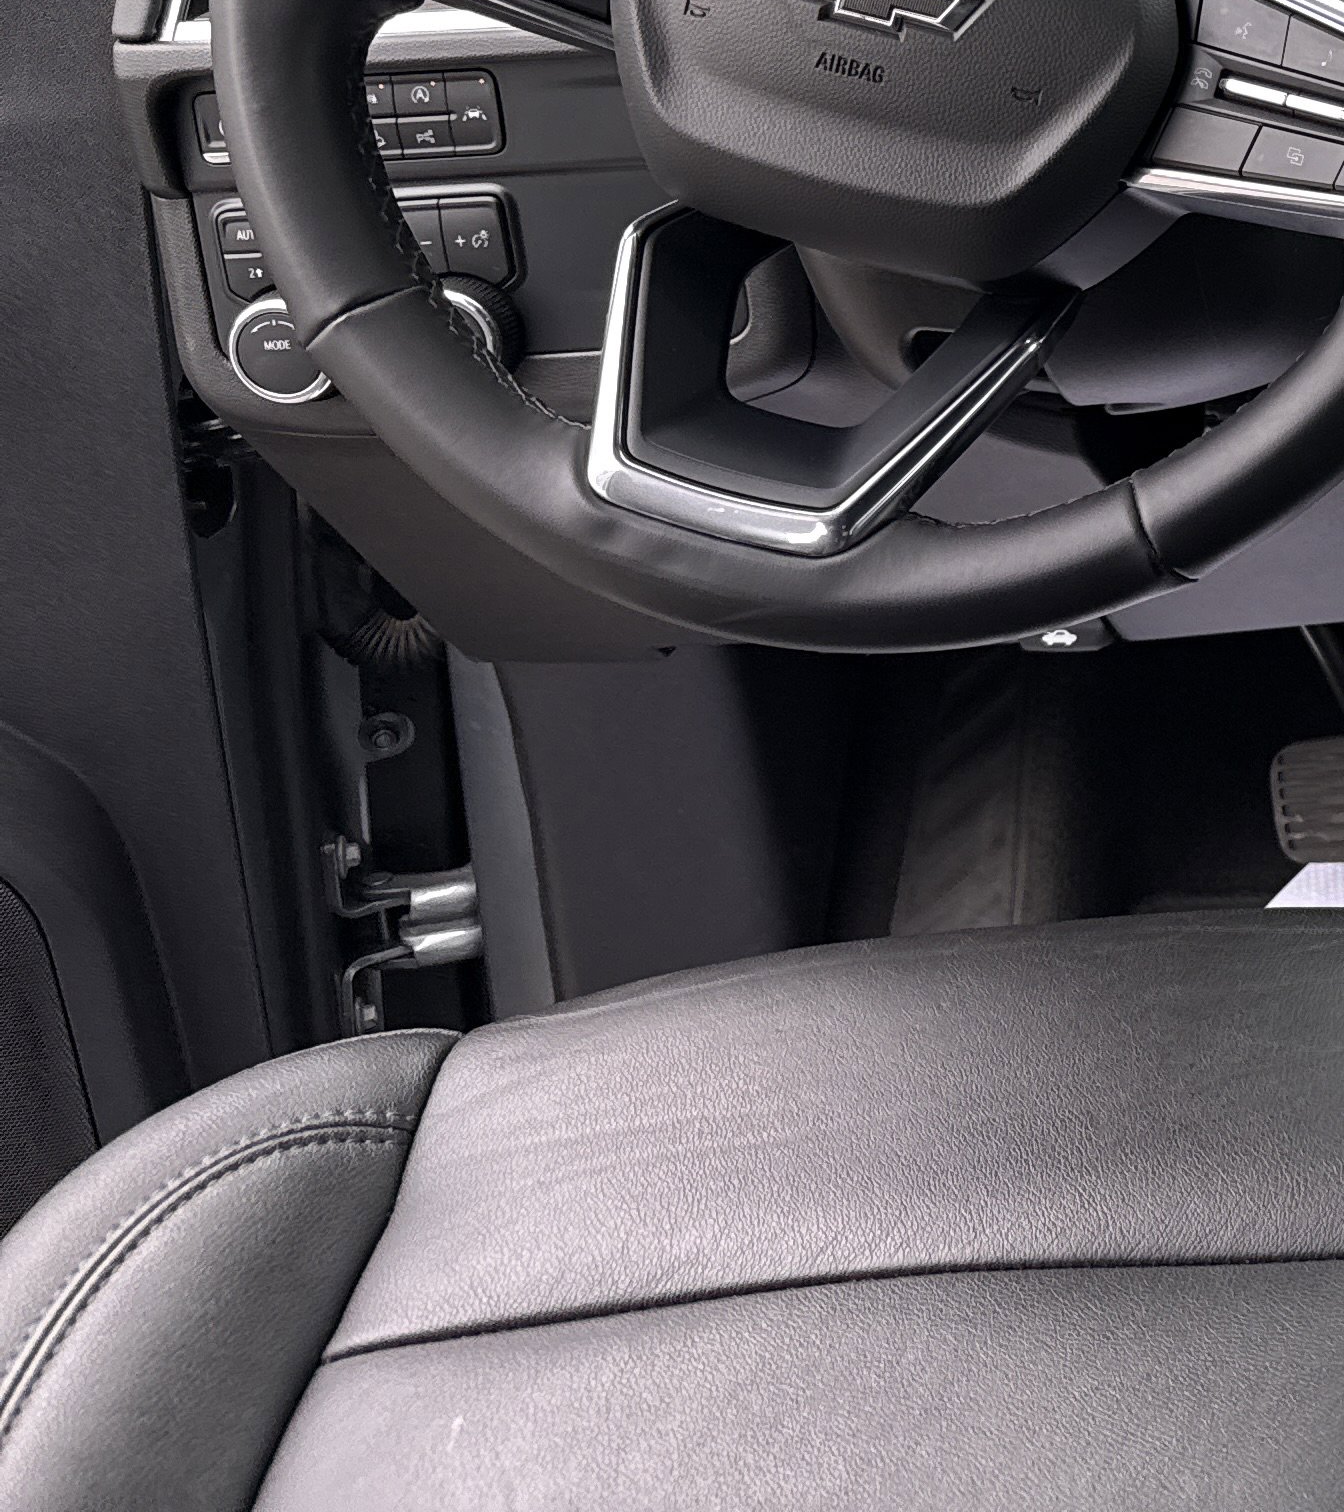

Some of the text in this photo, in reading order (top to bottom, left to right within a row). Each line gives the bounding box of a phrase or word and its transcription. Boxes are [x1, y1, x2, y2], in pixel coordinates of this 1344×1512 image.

[814, 50, 886, 83] AIRBAG
[236, 229, 255, 241] AUT
[263, 338, 292, 352] MODE
